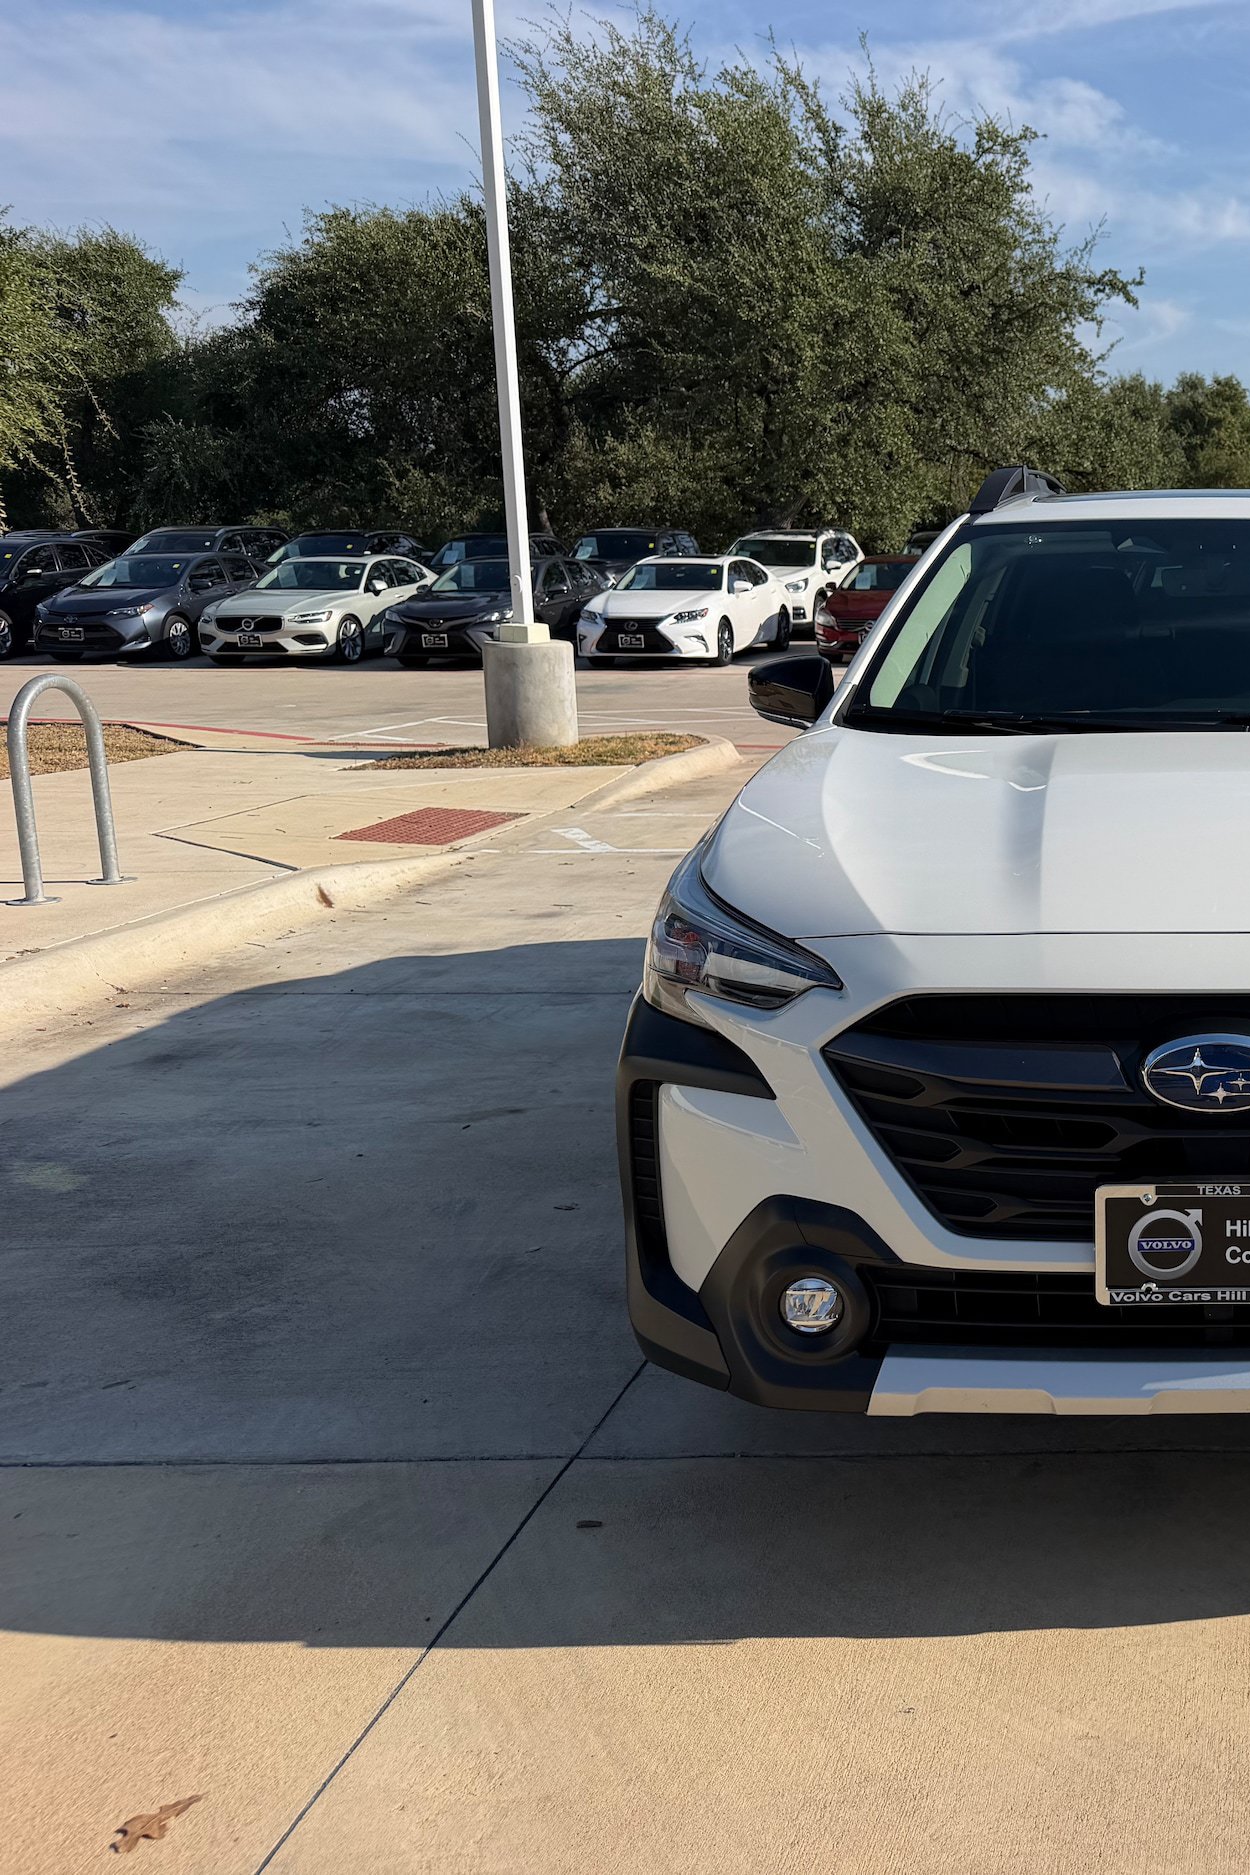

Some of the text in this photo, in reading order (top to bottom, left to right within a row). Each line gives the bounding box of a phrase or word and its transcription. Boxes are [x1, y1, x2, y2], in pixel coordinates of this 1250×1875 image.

[1197, 1186, 1241, 1195] TEXAS
[1140, 1240, 1192, 1250] VOLVO
[1111, 1291, 1163, 1302] Volvo
[1168, 1291, 1211, 1301] Cars
[1217, 1291, 1247, 1301] Hill
